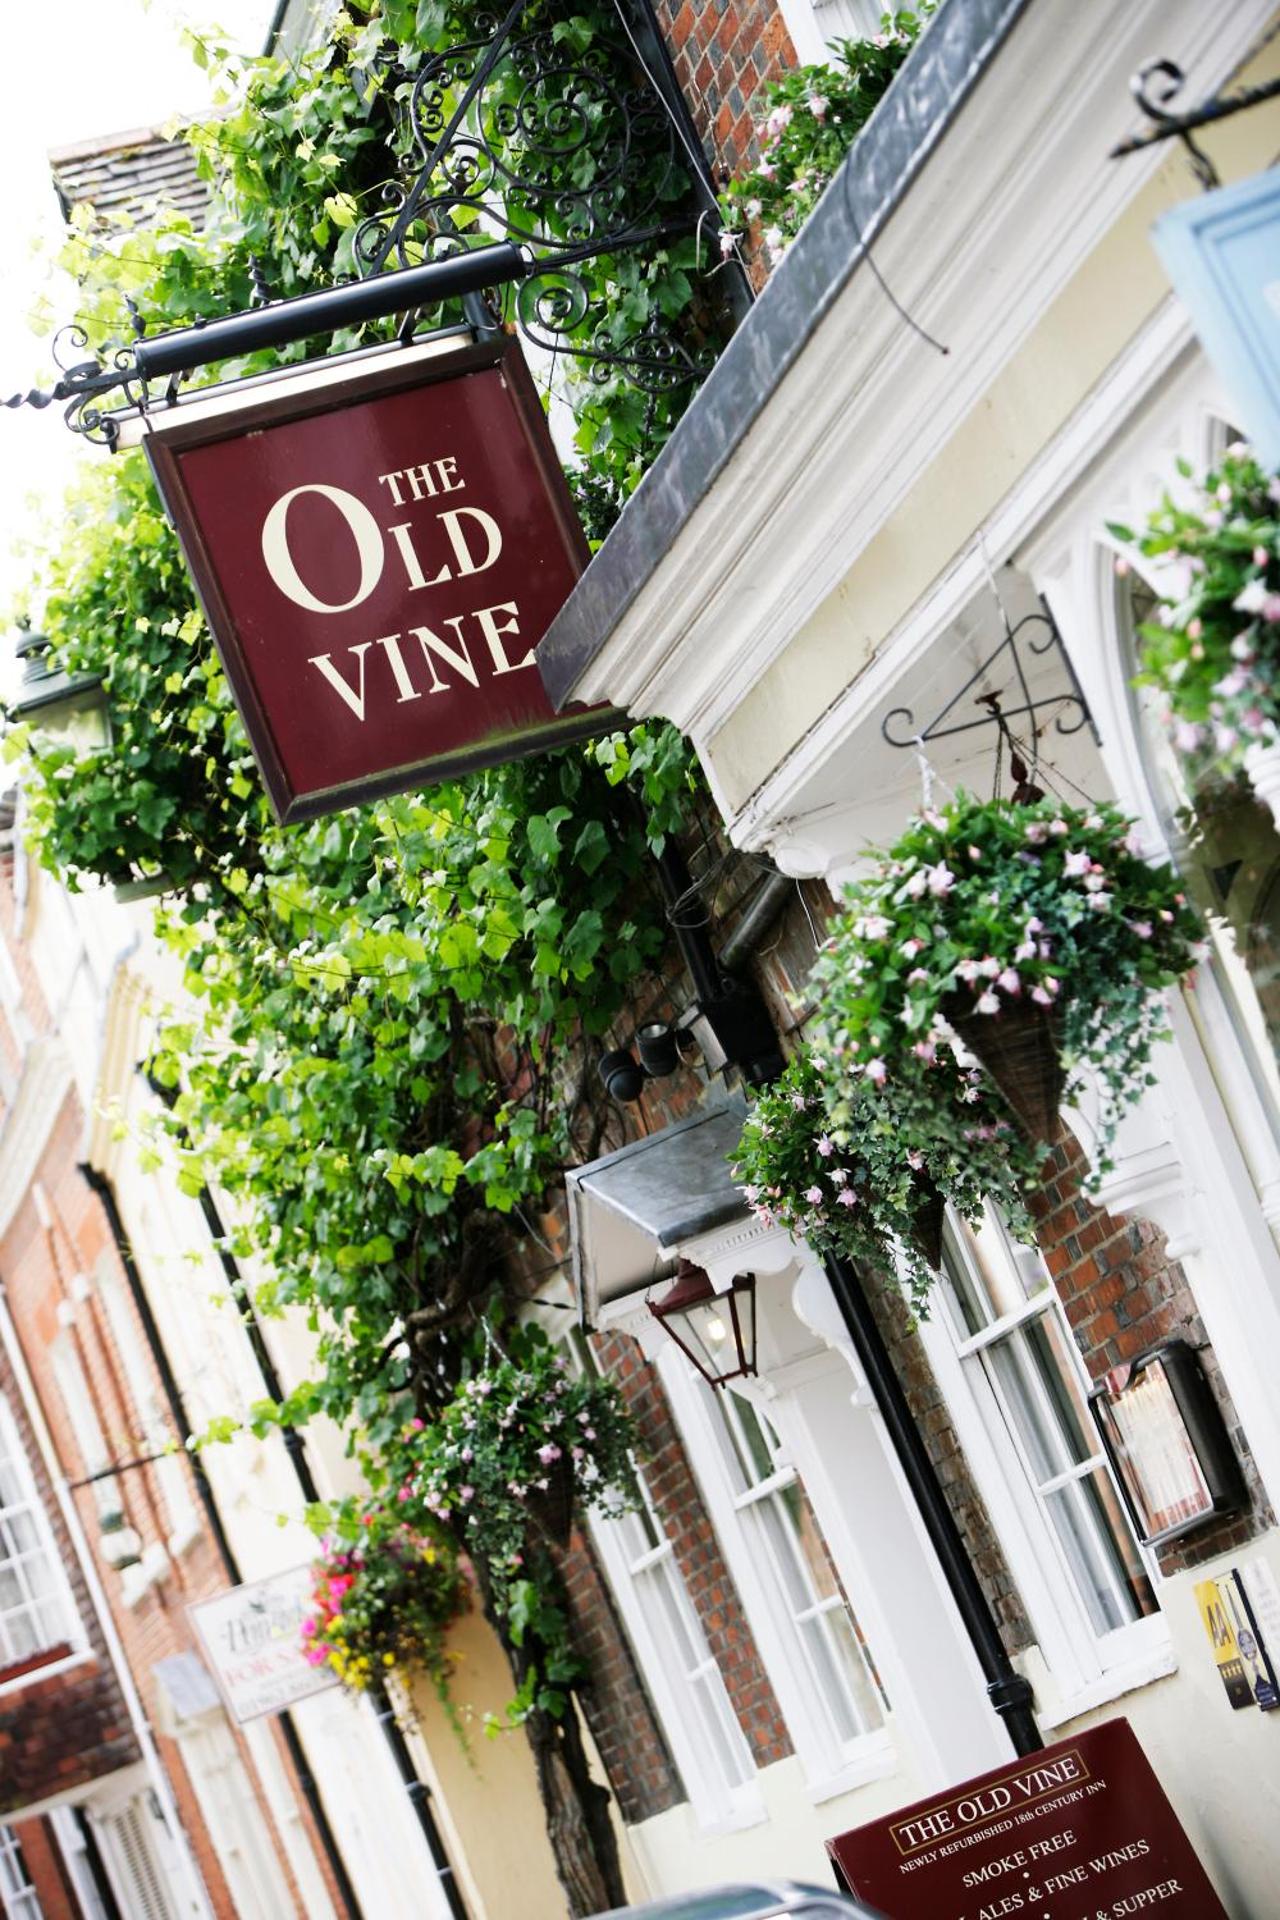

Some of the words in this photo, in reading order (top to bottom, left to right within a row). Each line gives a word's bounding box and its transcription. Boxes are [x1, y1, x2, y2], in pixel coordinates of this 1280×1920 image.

[379, 456, 466, 506] THE
[261, 484, 503, 614] OLD
[307, 601, 537, 721] VINE
[1207, 1602, 1232, 1649] AA
[899, 1810, 955, 1846] THE
[957, 1788, 1011, 1822] OLD
[1012, 1757, 1080, 1796] VINE
[899, 1850, 938, 1874] NEWLY
[939, 1819, 1013, 1857] REFURBISHED
[1014, 1811, 1036, 1825] 18th
[1035, 1788, 1084, 1816] CENTURY
[1085, 1779, 1107, 1796] INN
[962, 1851, 1028, 1888] SMOKE
[1029, 1829, 1077, 1860] FREE
[979, 1893, 1024, 1920] ALES
[1028, 1886, 1043, 1903] &
[1044, 1865, 1089, 1894] FINE
[1088, 1839, 1150, 1873] WINES
[1112, 1879, 1183, 1918] SUPPER
